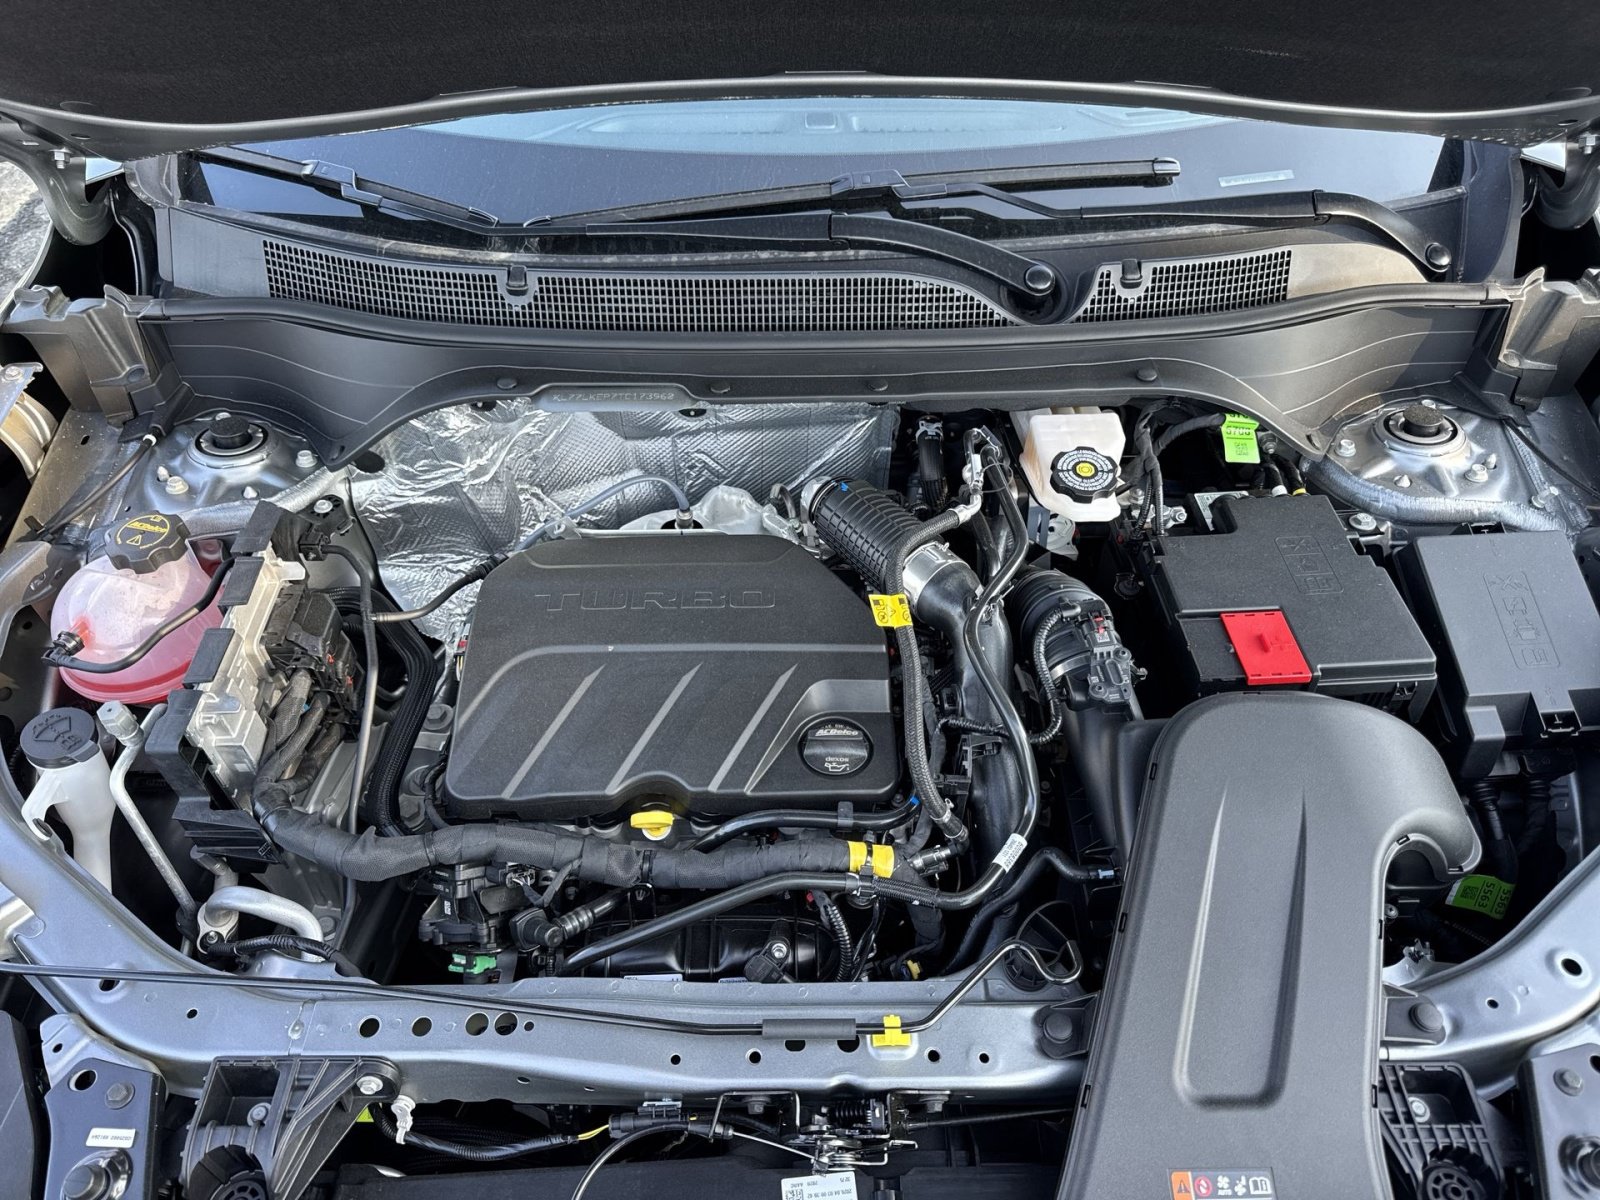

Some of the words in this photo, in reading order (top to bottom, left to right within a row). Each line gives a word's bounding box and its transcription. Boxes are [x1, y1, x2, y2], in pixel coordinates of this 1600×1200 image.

[534, 591, 776, 611] TURBO
[1478, 881, 1496, 909] 5563
[1495, 888, 1512, 915] 5563
